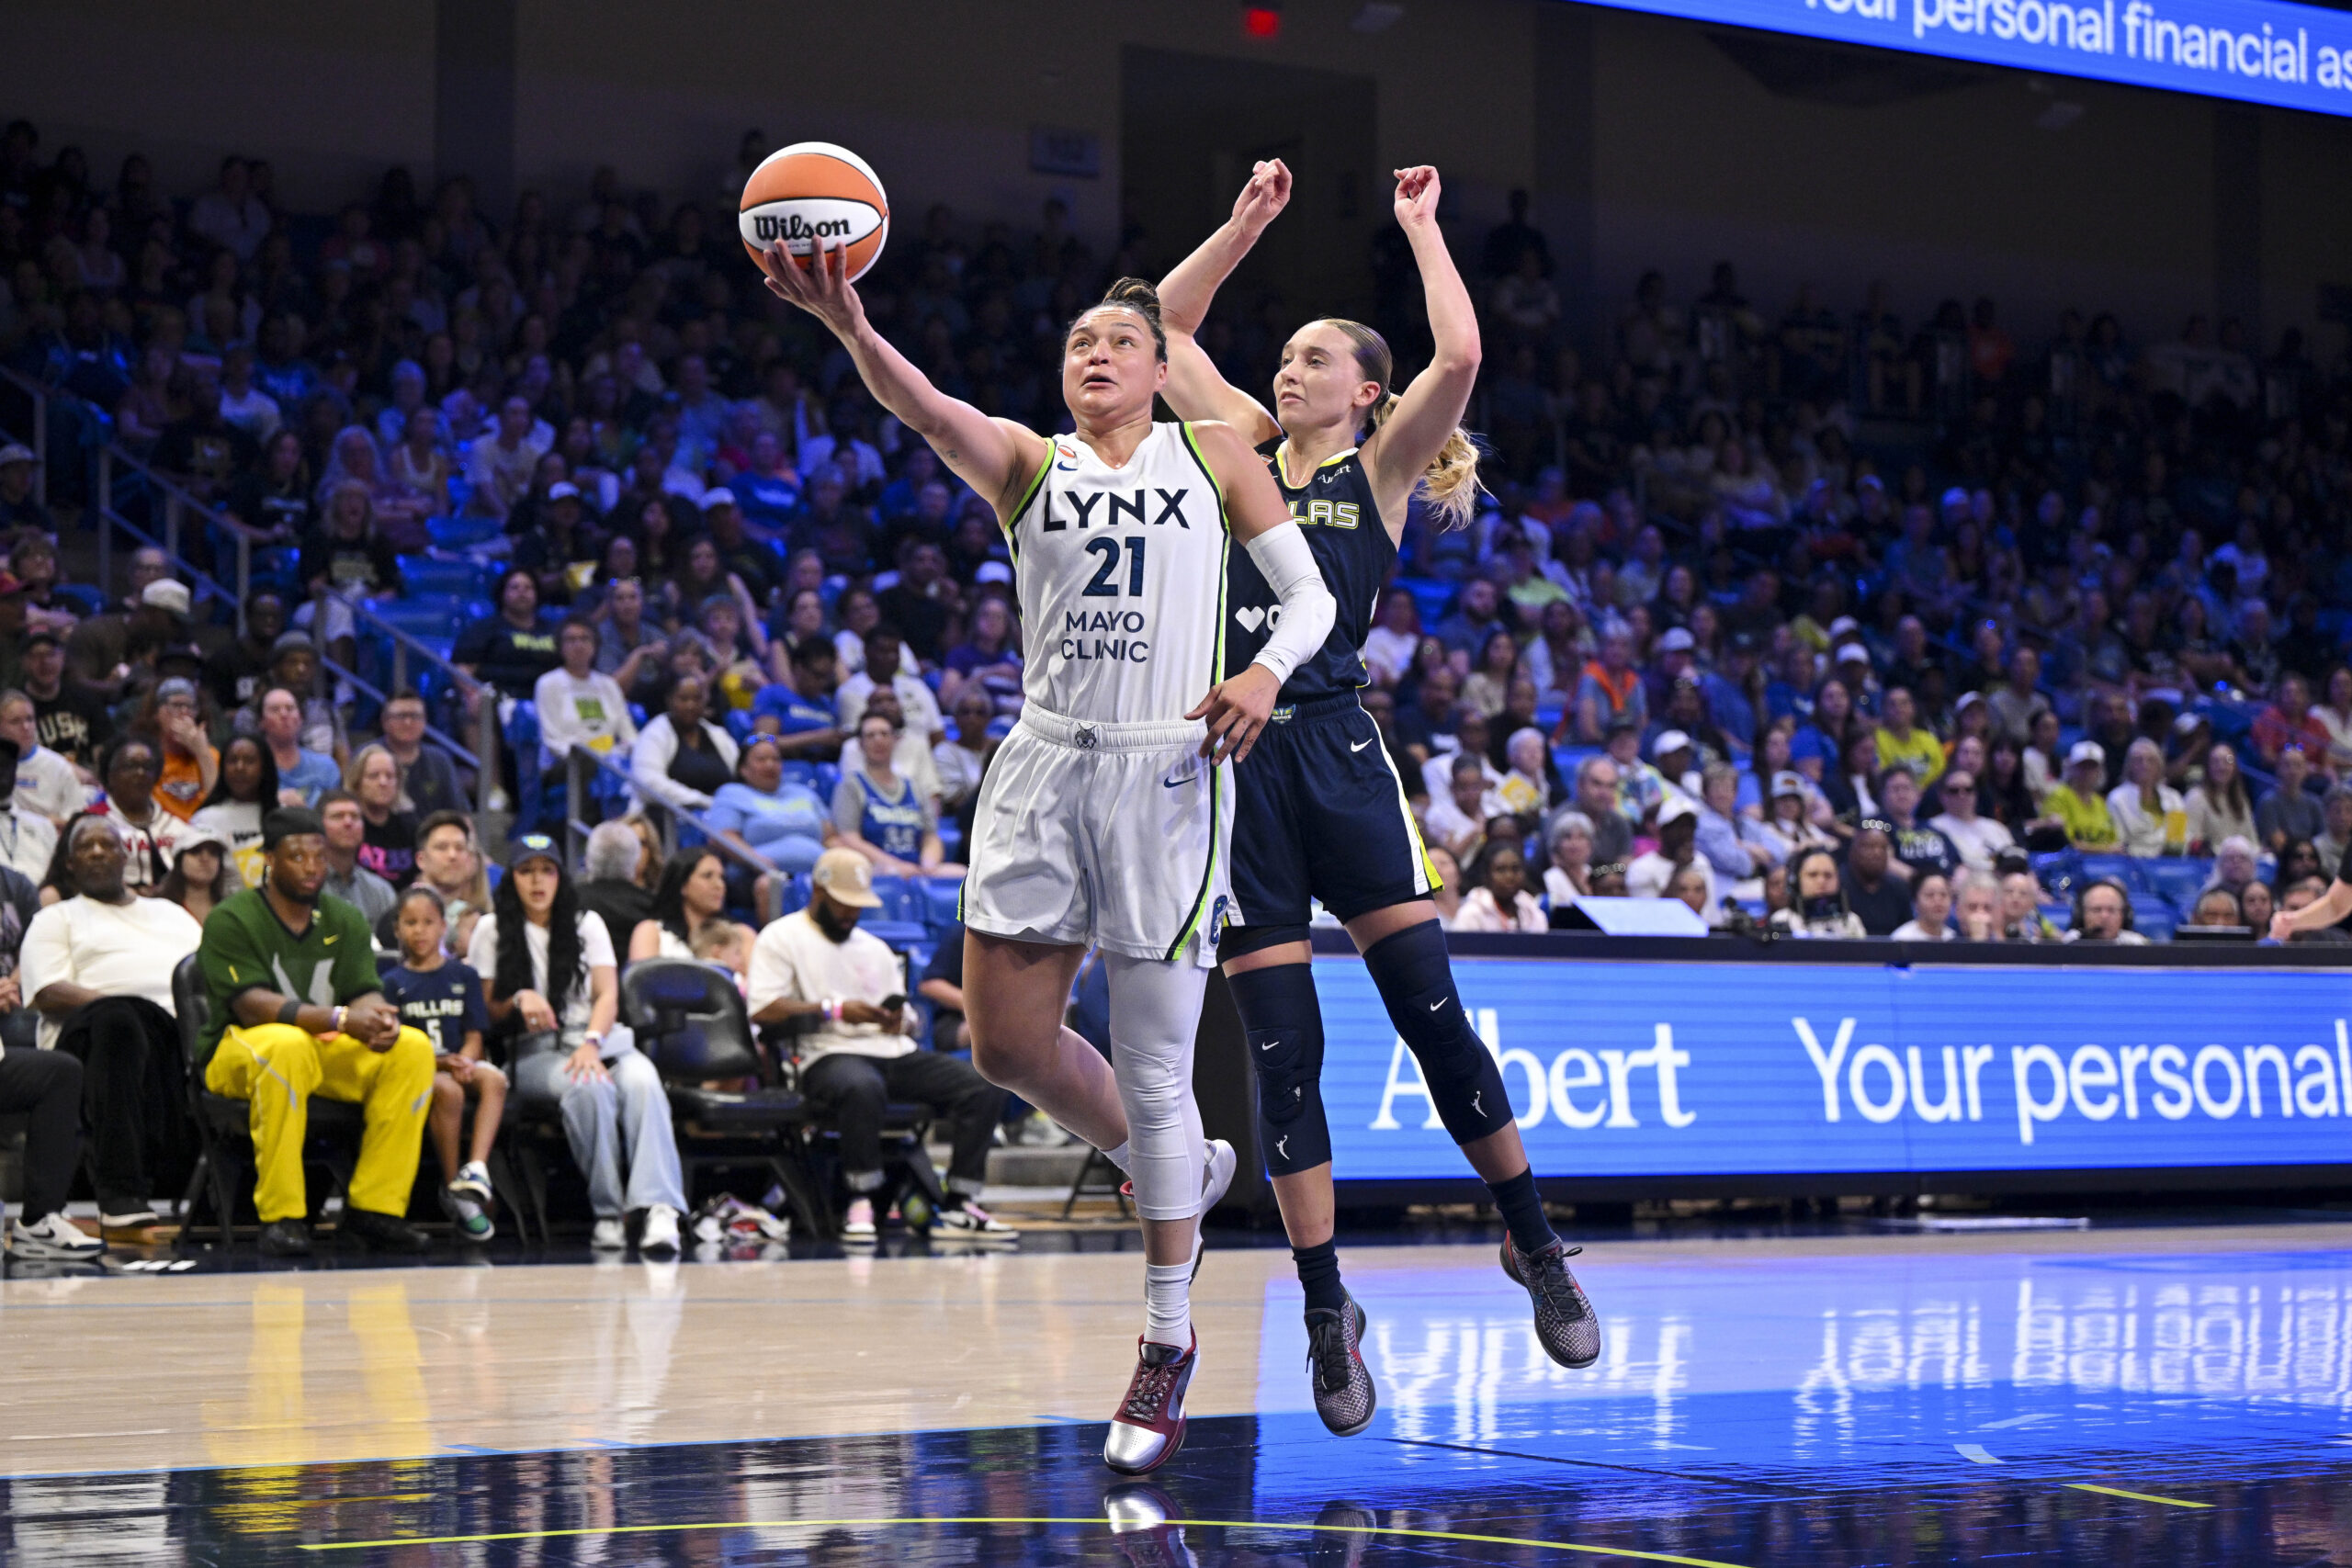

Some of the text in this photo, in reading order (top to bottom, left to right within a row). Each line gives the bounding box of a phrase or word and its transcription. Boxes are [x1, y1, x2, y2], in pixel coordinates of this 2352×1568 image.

[1913, 0, 2114, 55] personal
[2121, 1, 2308, 85] financial
[753, 214, 853, 241] Wilson
[1044, 489, 1191, 532] LYNX
[1287, 499, 1360, 530] LAS
[1081, 536, 1146, 597] 21
[1066, 611, 1145, 633] MAYO
[1061, 638, 1148, 663] CLINIC
[1369, 1009, 1697, 1131] Abert
[1791, 1017, 2352, 1145] Your personal
